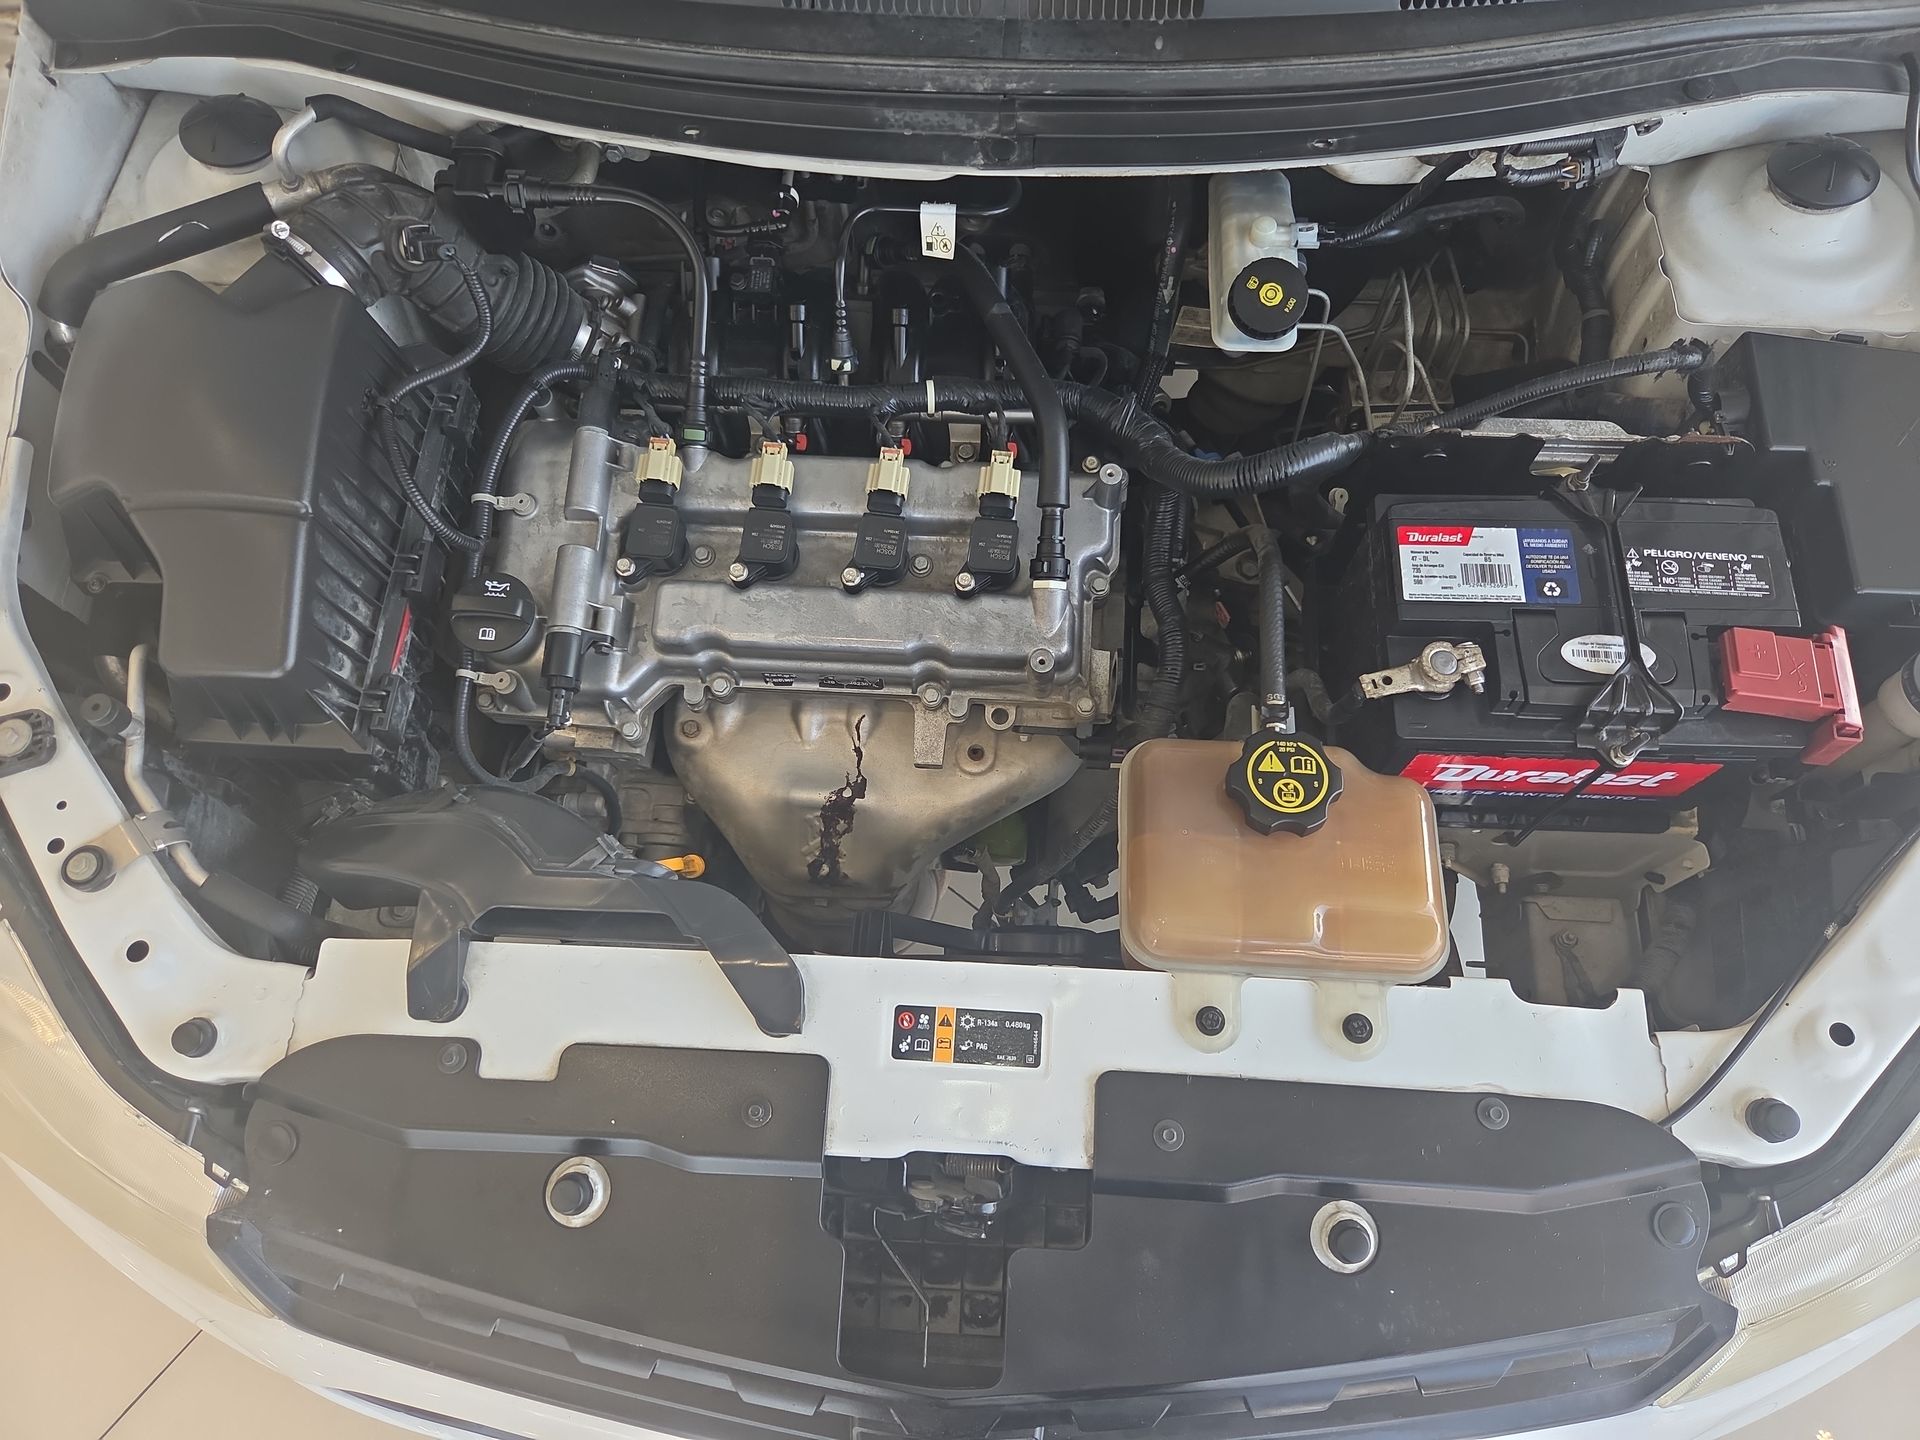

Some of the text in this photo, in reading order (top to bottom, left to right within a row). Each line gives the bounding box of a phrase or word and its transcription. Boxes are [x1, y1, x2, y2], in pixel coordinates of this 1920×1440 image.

[1287, 297, 1297, 310] DOT
[1406, 532, 1463, 543] Duralast
[876, 548, 896, 556] BOSCH
[1643, 548, 1747, 561] PELIGRO/VENENO
[989, 553, 1010, 561] BOSCH
[1662, 576, 1675, 585] NO
[1498, 790, 1637, 801] MANTENMIENTO
[977, 1019, 998, 1027] R-134a
[976, 1042, 988, 1050] PAG
